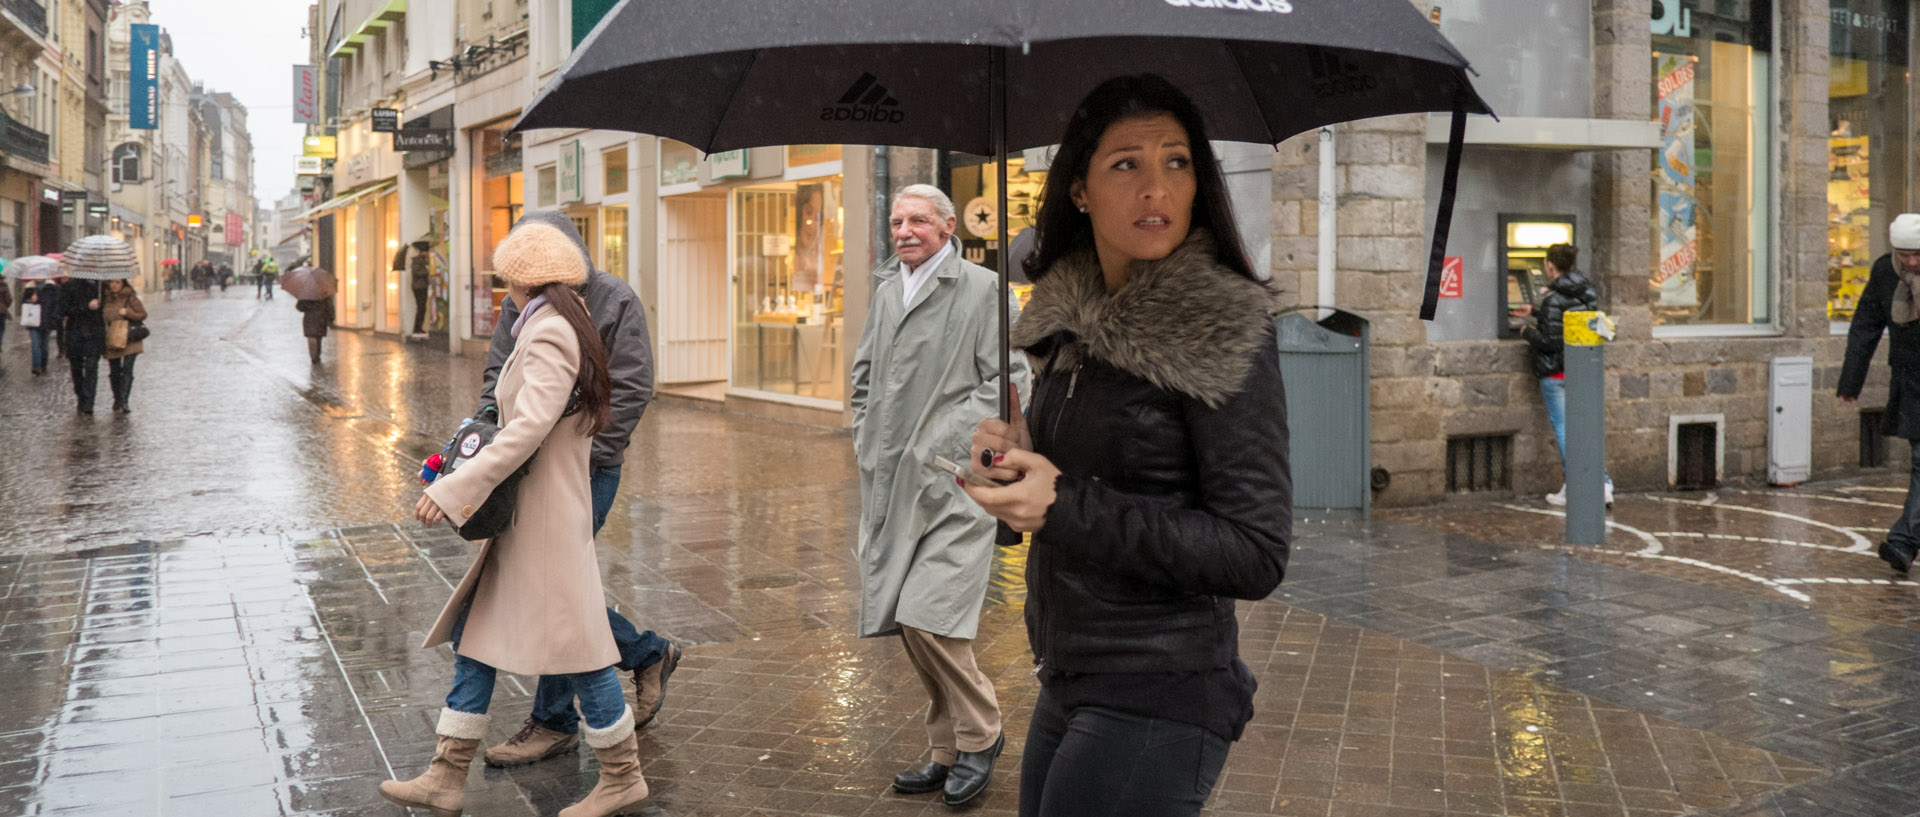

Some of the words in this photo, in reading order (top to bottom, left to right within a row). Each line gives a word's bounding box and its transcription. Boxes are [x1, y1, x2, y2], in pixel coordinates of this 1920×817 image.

[296, 70, 313, 119] Etam
[1658, 62, 1694, 97] SOLDES
[147, 86, 156, 126] ARMAND
[1659, 246, 1696, 281] SOLDES
